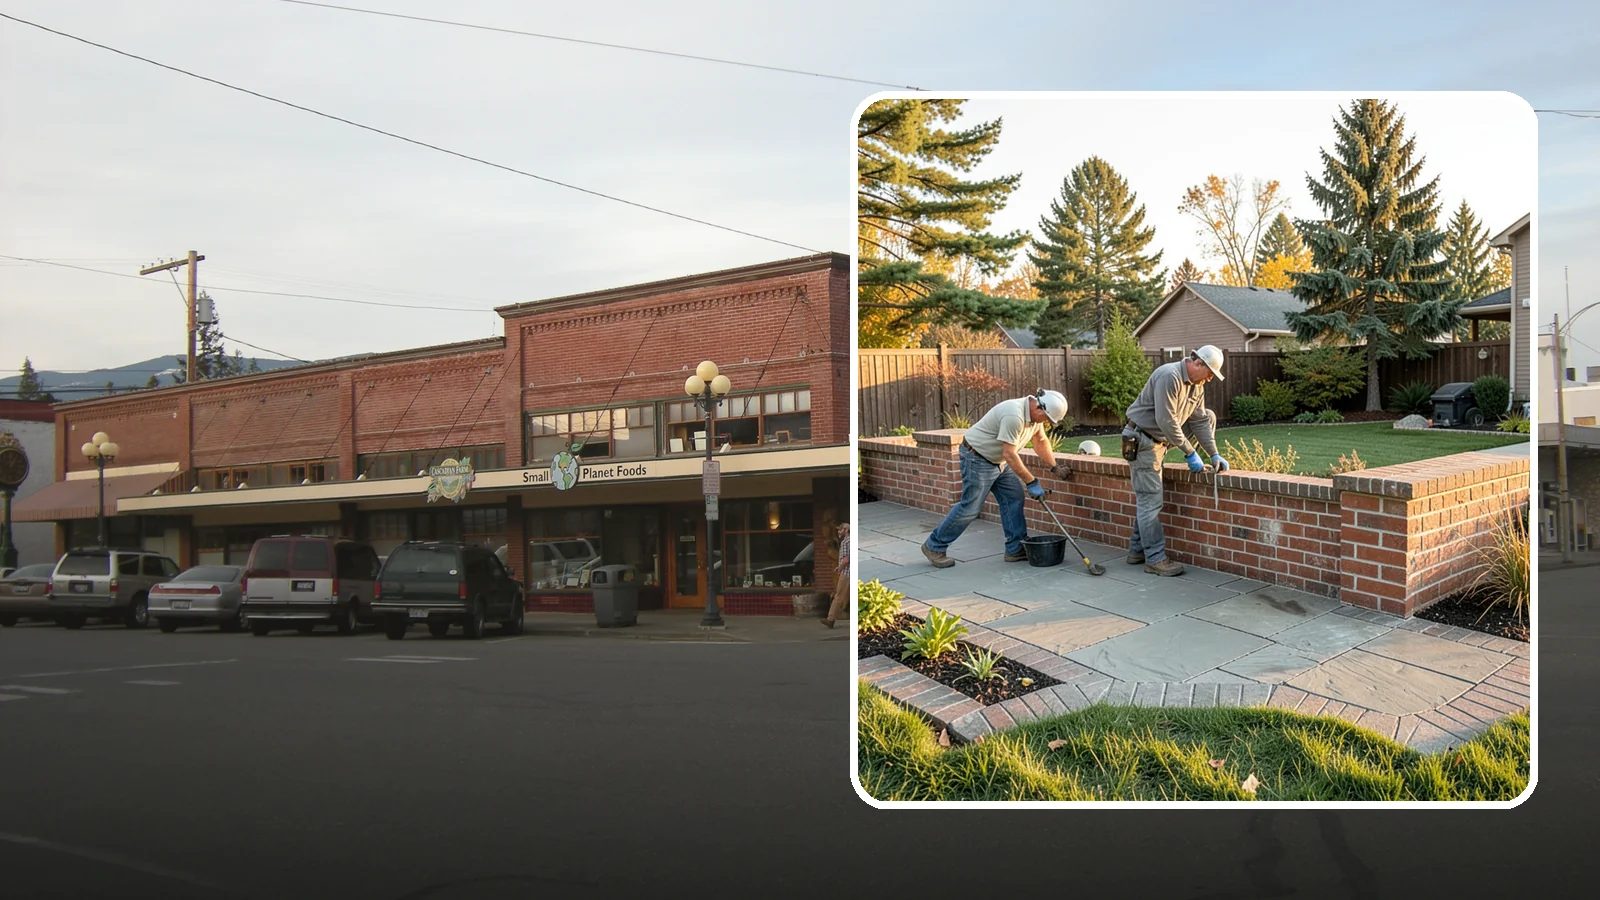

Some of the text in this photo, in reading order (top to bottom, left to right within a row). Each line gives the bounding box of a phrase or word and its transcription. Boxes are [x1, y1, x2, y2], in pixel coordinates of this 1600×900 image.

[523, 464, 647, 483] Small Planet Foods
